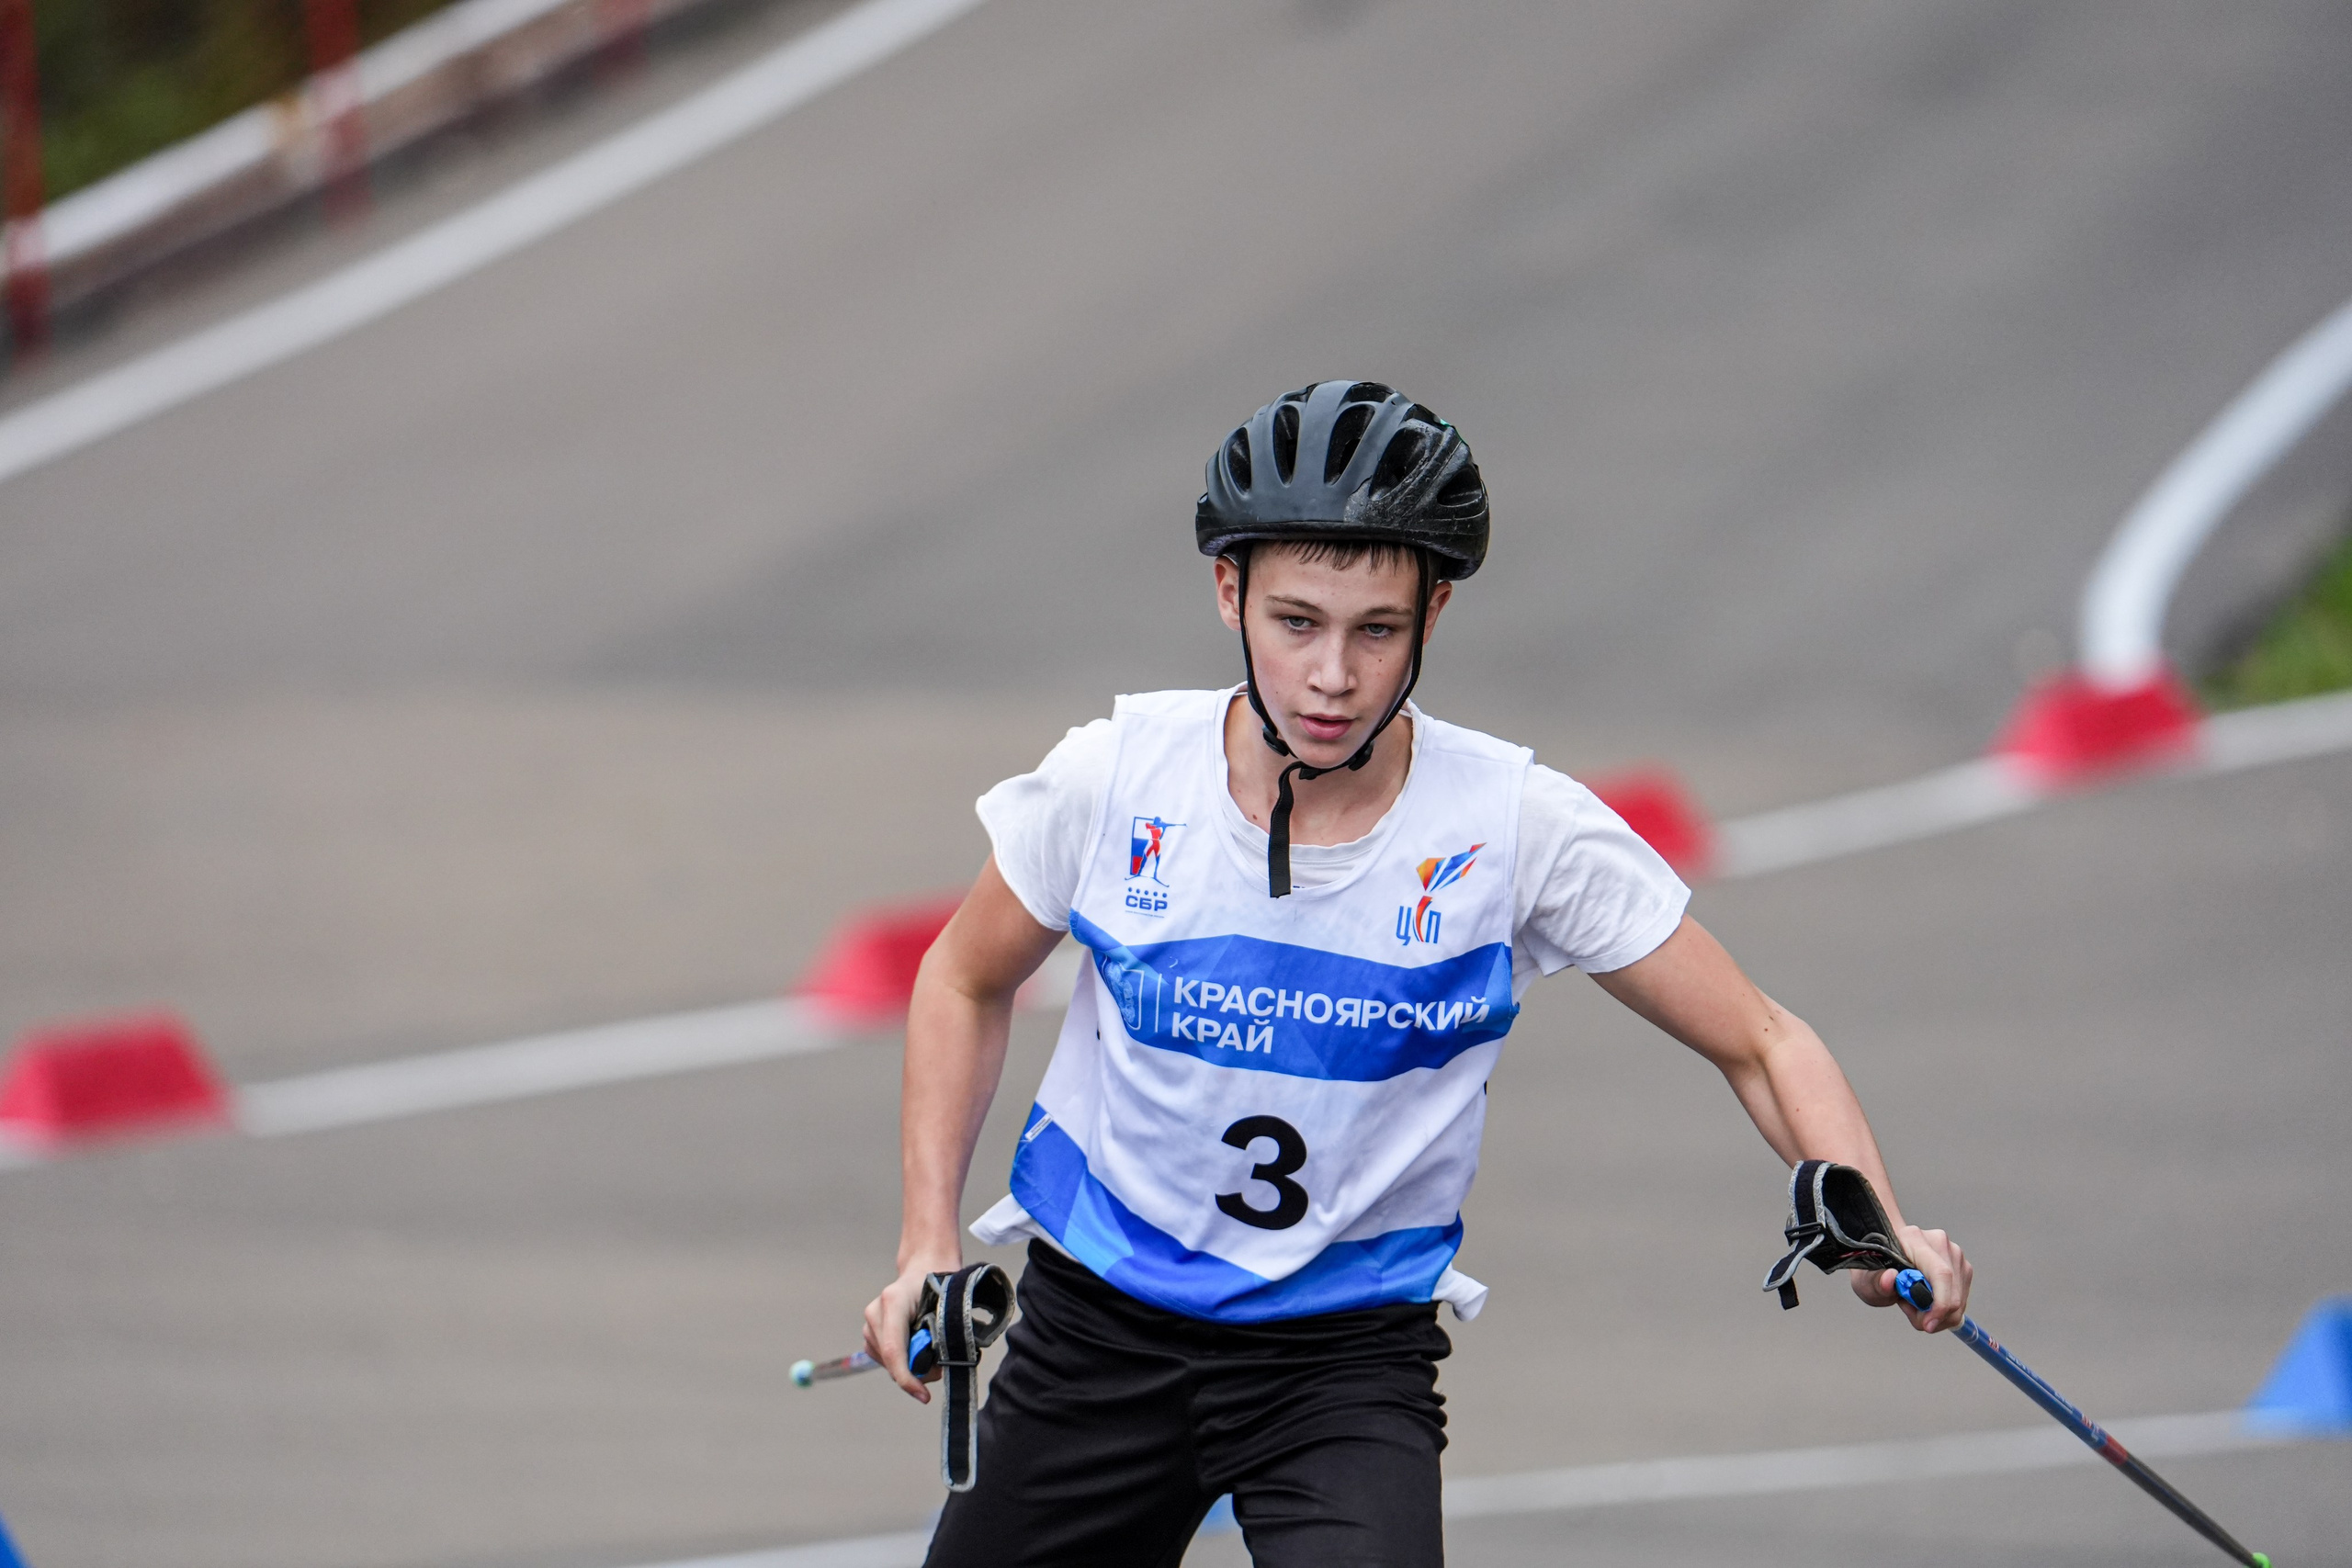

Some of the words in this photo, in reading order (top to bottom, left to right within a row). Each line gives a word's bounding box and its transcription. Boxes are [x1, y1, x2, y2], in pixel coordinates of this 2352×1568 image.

[1125, 895, 1168, 911] СБР
[1173, 976, 1490, 1032] КРАСНОЯРСКИЙ
[1171, 1011, 1274, 1055] КРАЙ
[1215, 1114, 1309, 1231] 3
